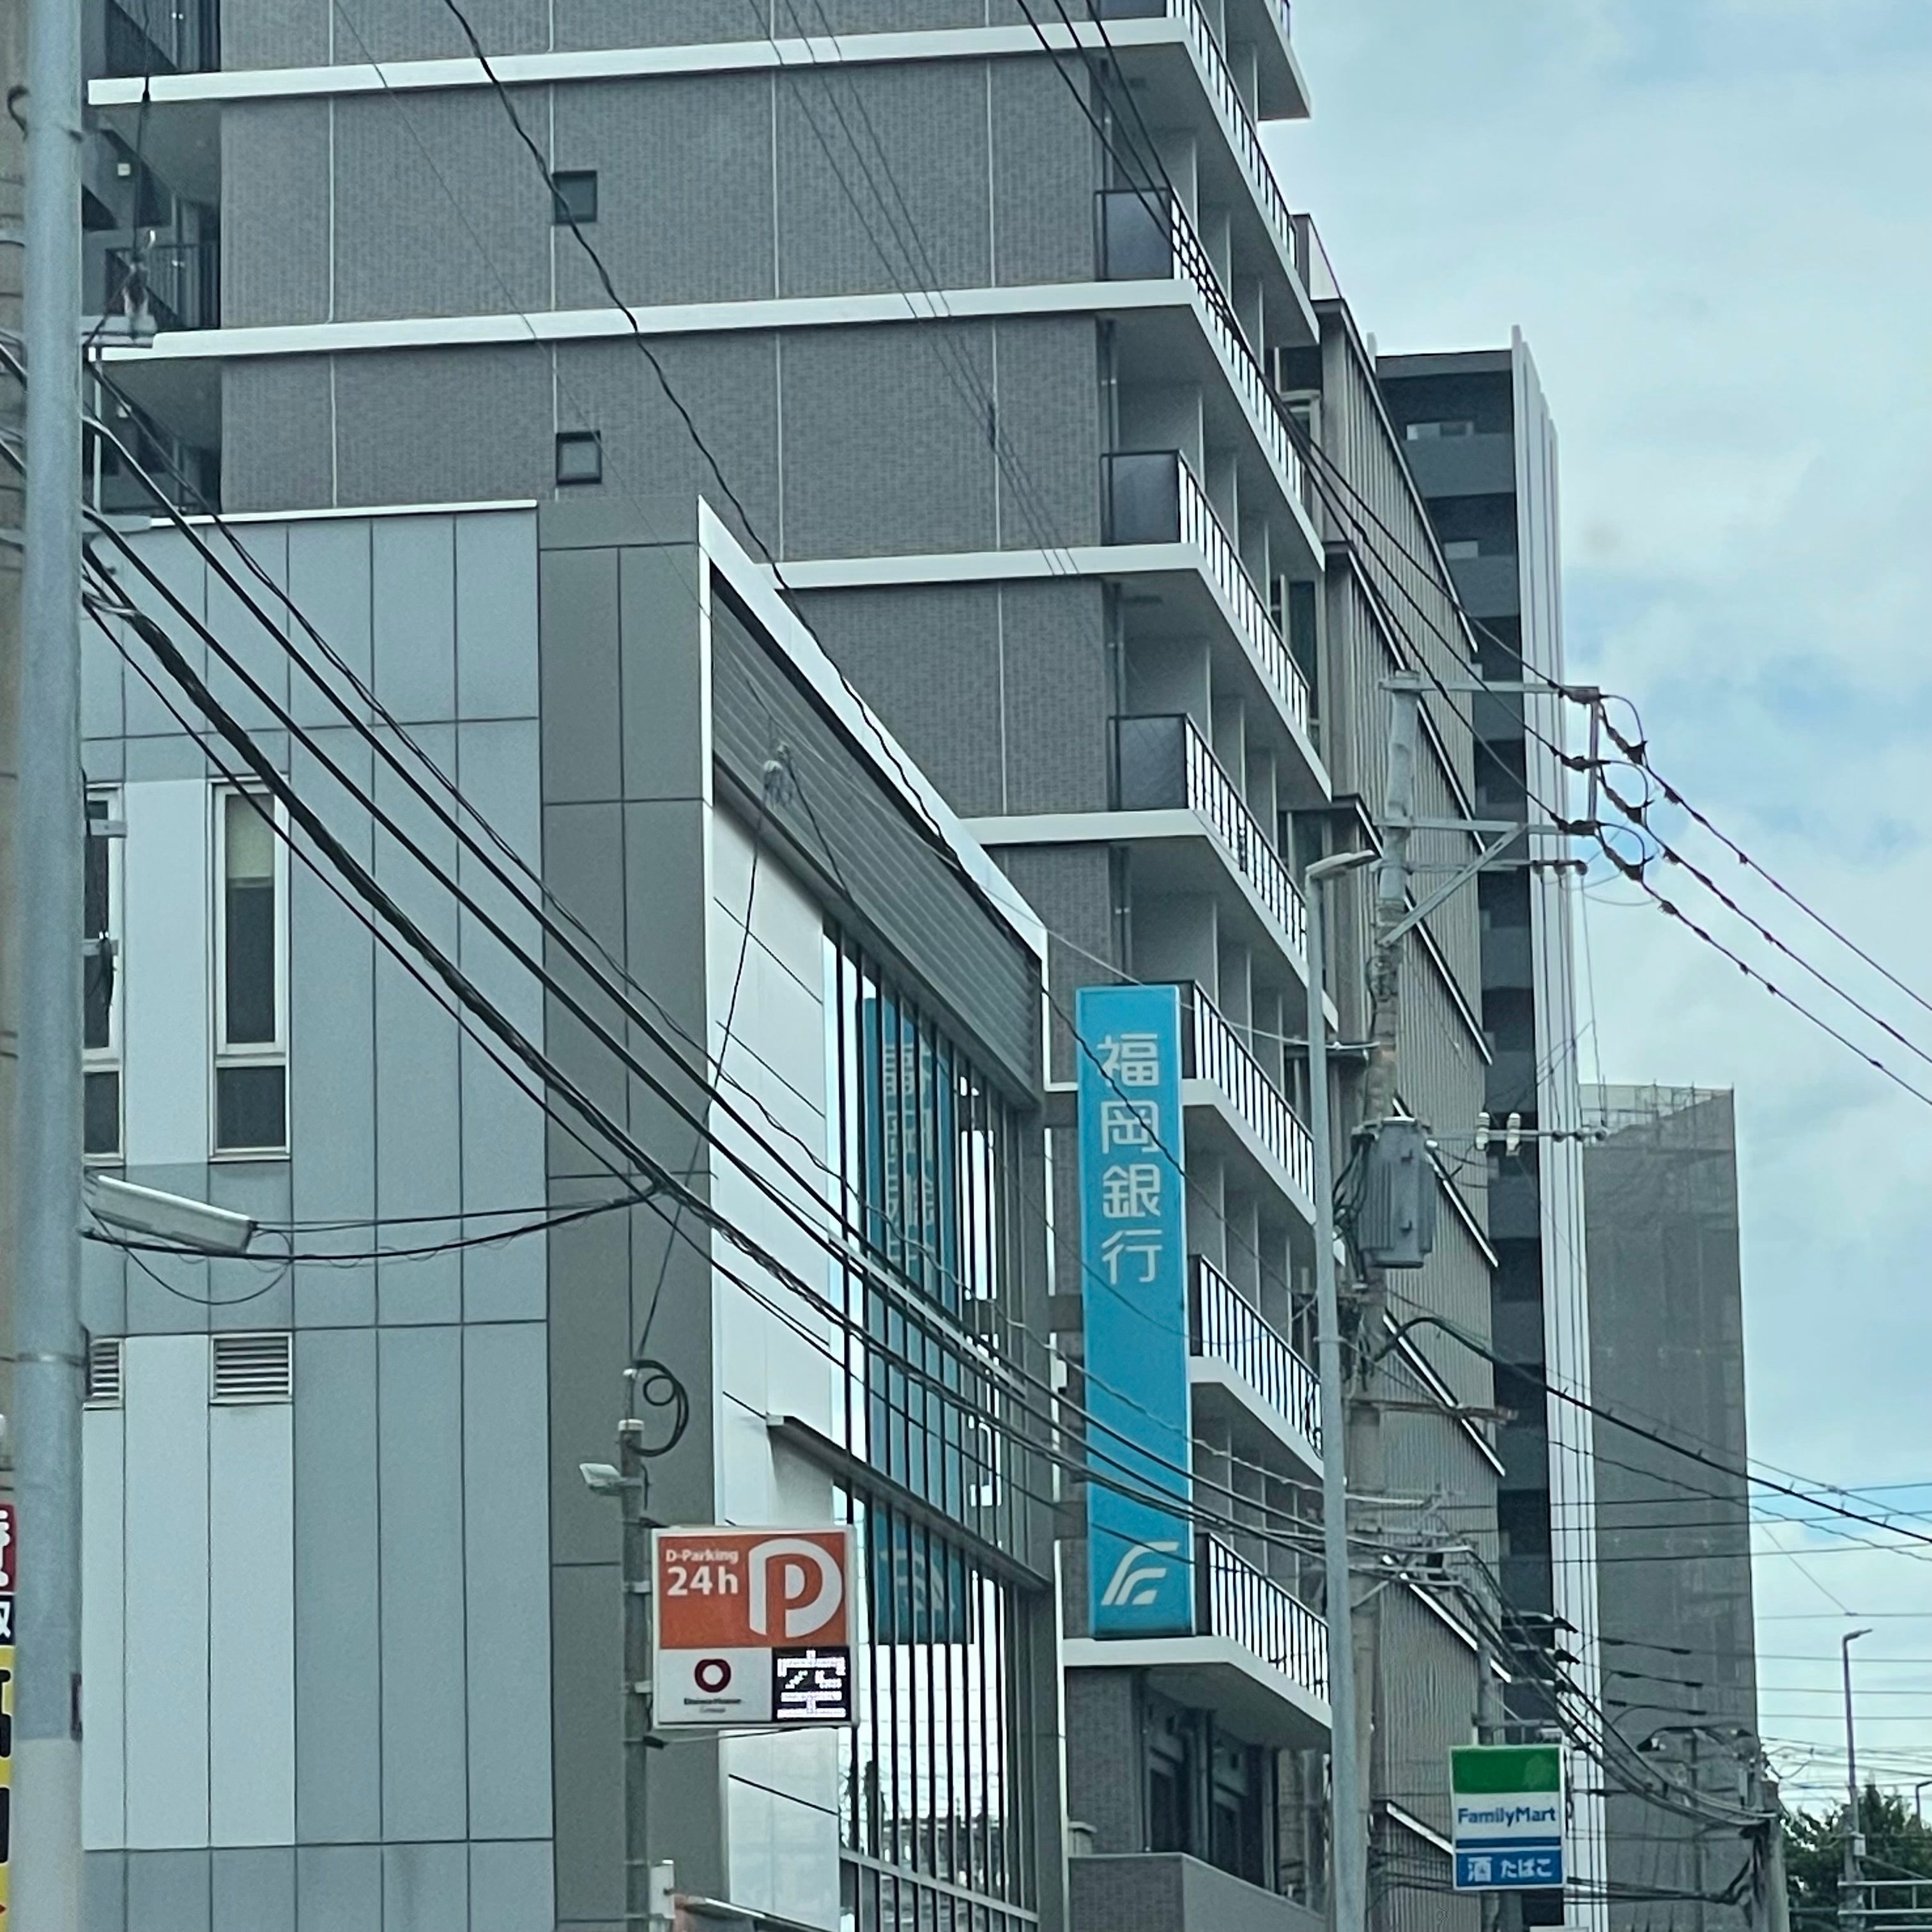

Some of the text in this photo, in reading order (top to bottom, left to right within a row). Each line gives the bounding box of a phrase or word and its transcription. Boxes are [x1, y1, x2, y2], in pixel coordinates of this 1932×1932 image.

[1097, 1032, 1163, 1285] 福岡銀行
[666, 1549, 739, 1564] D-Parking
[666, 1566, 739, 1596] 24h
[748, 1538, 843, 1639] P
[776, 1649, 847, 1719] 空
[1457, 1807, 1556, 1828] FamilyMart
[1468, 1856, 1552, 1882] 酒 たばこ
